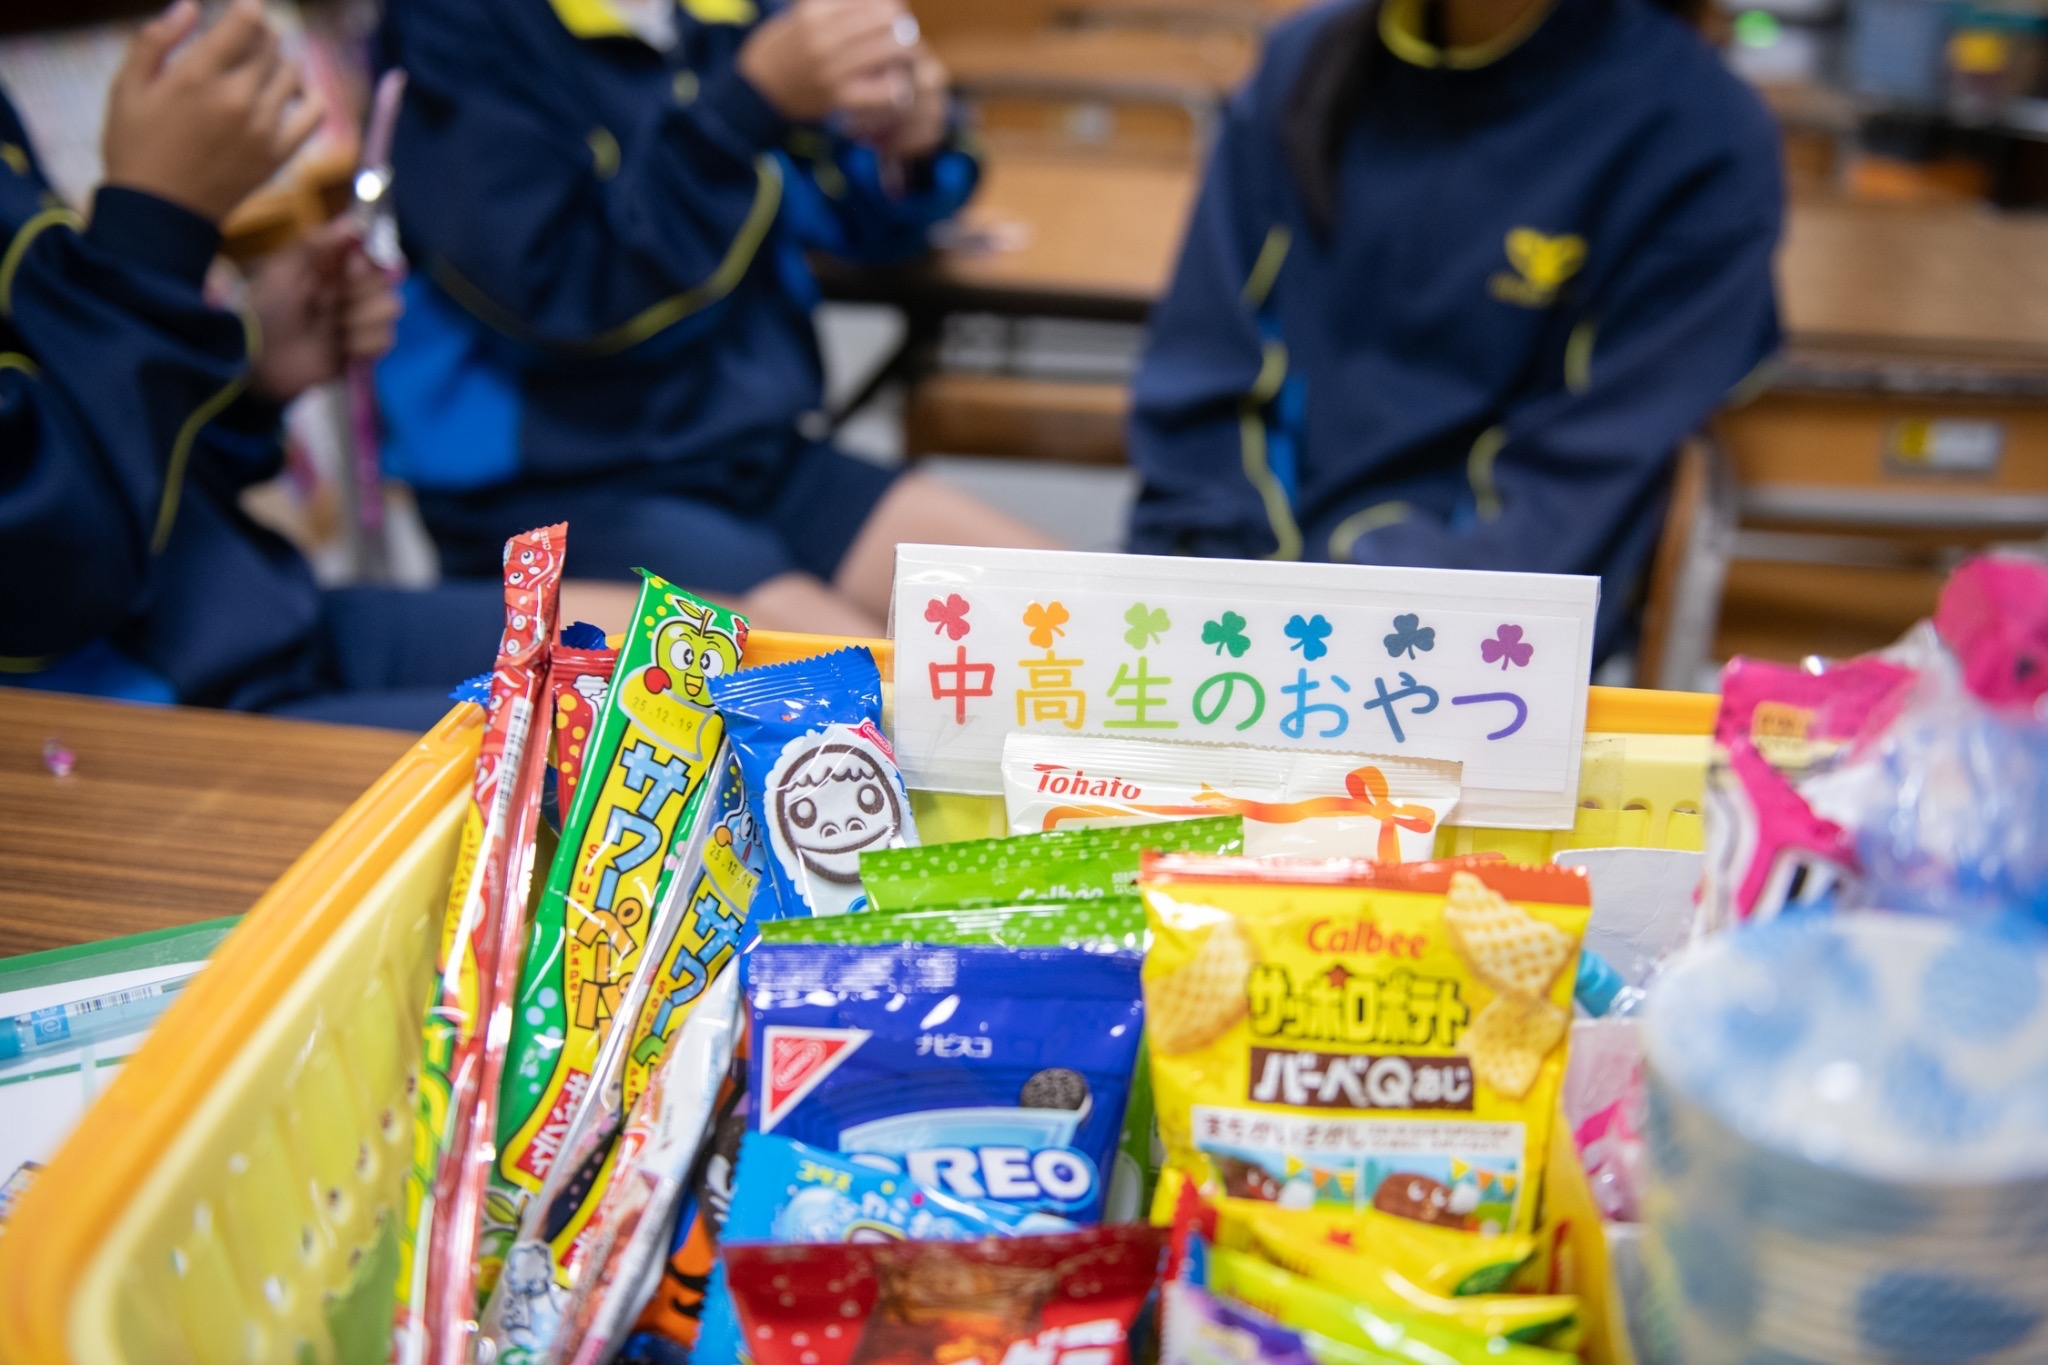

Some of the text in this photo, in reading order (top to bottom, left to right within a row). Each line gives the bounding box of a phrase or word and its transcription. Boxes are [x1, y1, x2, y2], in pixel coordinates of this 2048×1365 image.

[632, 696, 694, 732] 25.12.19
[929, 647, 1528, 743] 中高生のおやつ
[1033, 763, 1142, 800] Tohato
[708, 845, 753, 889] 25.12.14
[574, 738, 692, 1048] サワーペーパ
[1306, 918, 1427, 960] Calbee
[914, 1034, 993, 1059] ナビスコ
